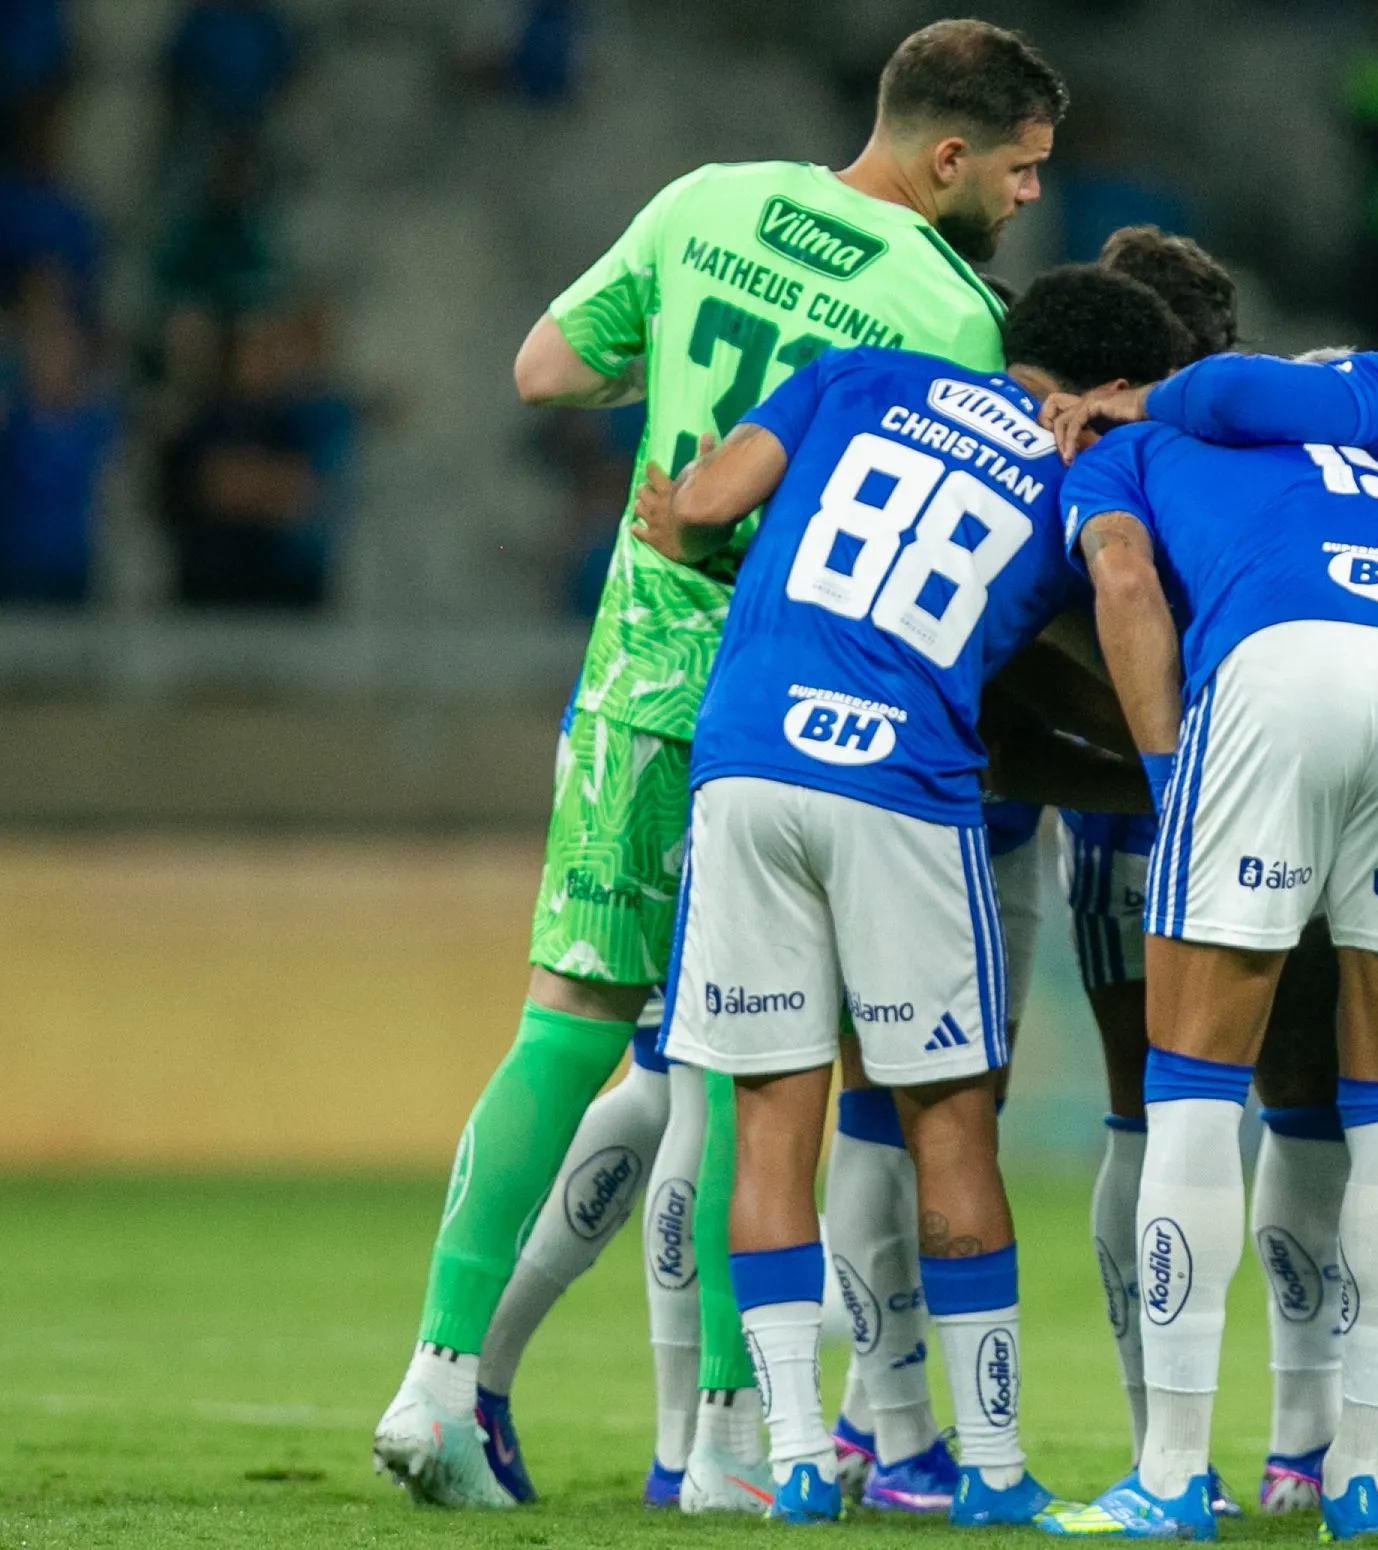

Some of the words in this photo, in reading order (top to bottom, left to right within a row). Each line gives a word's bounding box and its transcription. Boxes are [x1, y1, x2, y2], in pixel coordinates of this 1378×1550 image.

[682, 237, 803, 312] MATHEUS
[763, 202, 867, 272] Vilma
[938, 381, 1039, 449] Vilma
[881, 405, 1044, 503] CHRISTIAN
[785, 432, 1034, 670] 88
[787, 683, 908, 724] SUPERMERCADOS
[799, 706, 883, 752] BH
[1266, 861, 1312, 890] álamo
[725, 985, 806, 1015] álamo
[576, 1153, 634, 1231] Kodilar
[656, 1185, 686, 1278] Kodilar
[1148, 1225, 1172, 1313] Kodilar
[988, 1335, 1011, 1415] Kodilar
